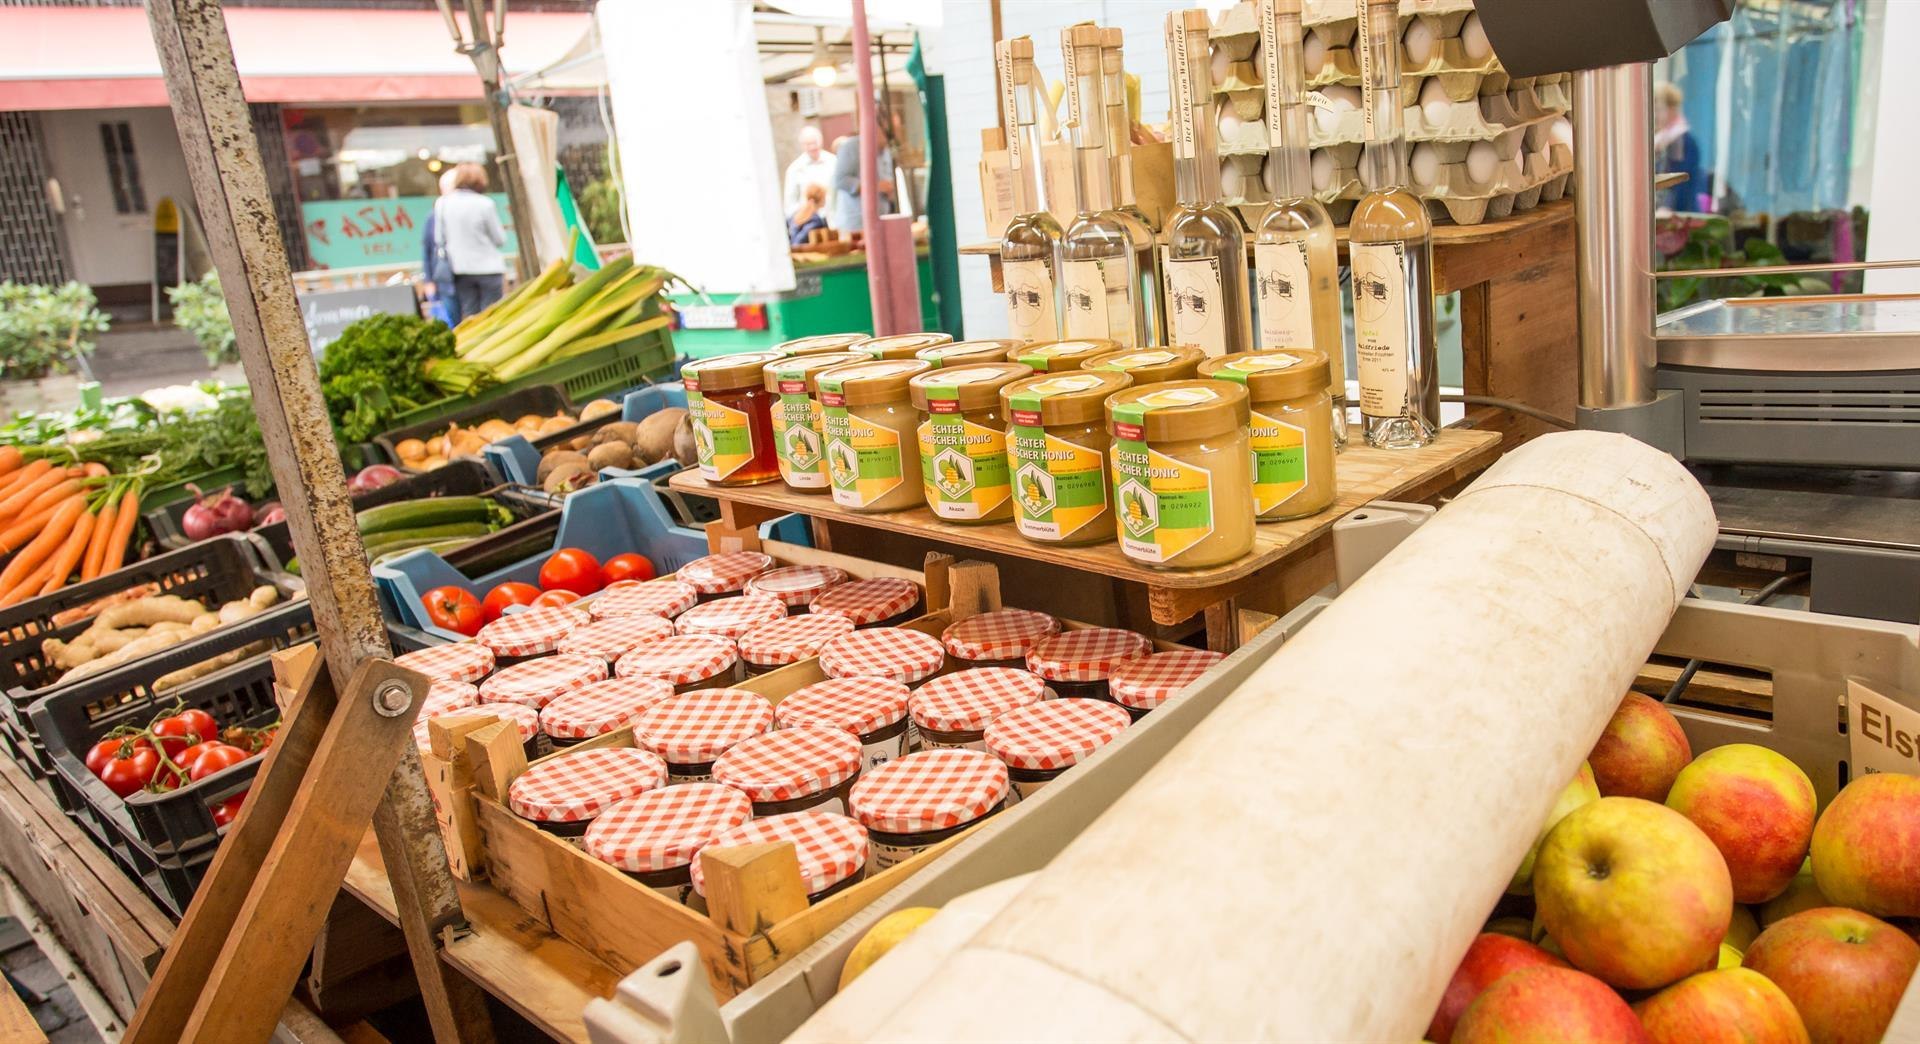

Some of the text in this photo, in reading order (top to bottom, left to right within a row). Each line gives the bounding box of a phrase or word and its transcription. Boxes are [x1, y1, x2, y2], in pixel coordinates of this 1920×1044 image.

[1265, 5, 1274, 58] Waldfriede
[1177, 25, 1186, 74] Waldfriede
[784, 404, 811, 412] ECHTER
[825, 416, 849, 426] ECHTER
[845, 427, 873, 437] HONIG
[932, 425, 963, 434] ECHTER
[959, 434, 992, 445] HONIG
[1016, 437, 1046, 449] ECHTER
[1041, 450, 1075, 460] HONIG
[1118, 450, 1149, 464] ECHTER
[1144, 467, 1180, 478] HONIG
